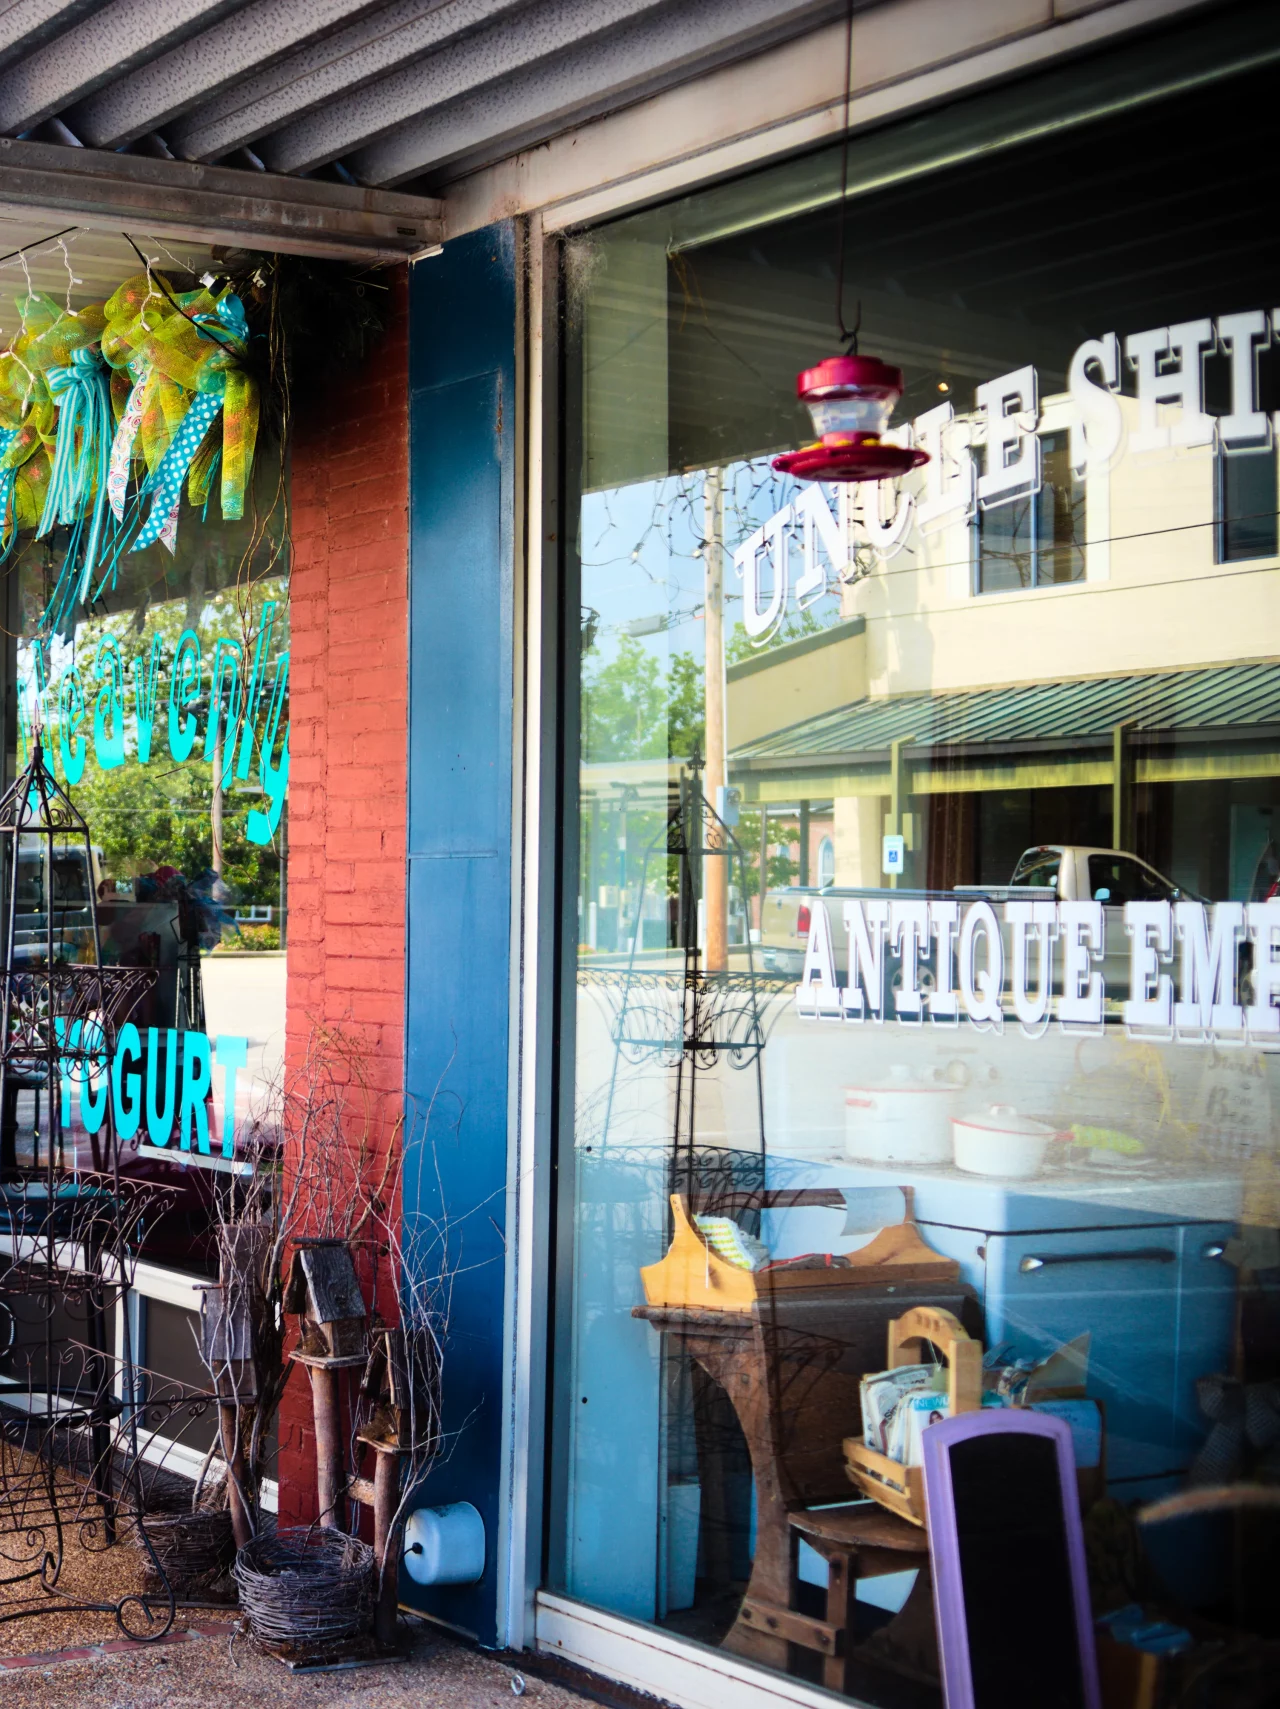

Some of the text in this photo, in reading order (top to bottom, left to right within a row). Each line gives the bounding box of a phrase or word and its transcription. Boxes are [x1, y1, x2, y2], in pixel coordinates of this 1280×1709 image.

[1066, 308, 1280, 482] SHI
[795, 900, 1106, 1040] ANTIQUE
[55, 1011, 248, 1158] YOGURT
